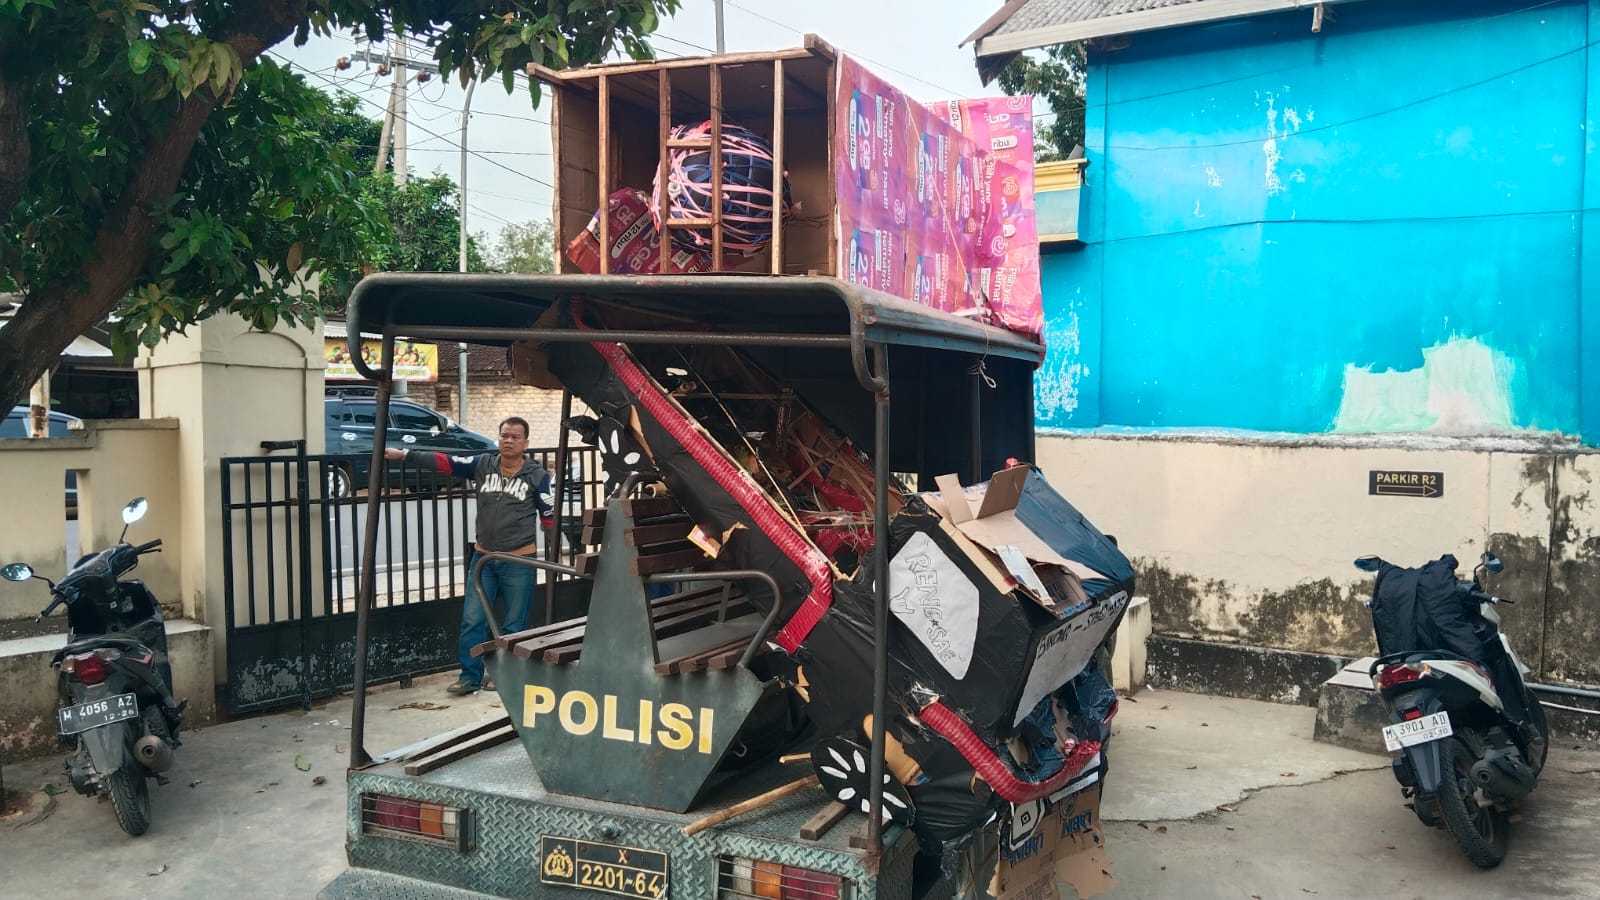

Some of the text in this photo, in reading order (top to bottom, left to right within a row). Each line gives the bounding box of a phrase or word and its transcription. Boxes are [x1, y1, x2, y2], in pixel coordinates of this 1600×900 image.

[858, 113, 871, 170] 2 GB
[992, 139, 1010, 148] ribu
[630, 246, 651, 271] GB
[857, 252, 869, 274] 2
[992, 267, 1006, 303] hemat
[480, 473, 529, 501] ADIDAS
[1376, 473, 1437, 485] PARKIR R2
[904, 552, 943, 620] RENG
[63, 695, 133, 721] M 4056 AZ
[104, 708, 135, 721] 12-26
[523, 684, 714, 755] POLISI
[1385, 714, 1446, 739] M 3901 AD
[618, 849, 628, 864] X
[581, 863, 661, 897] 2201-64
